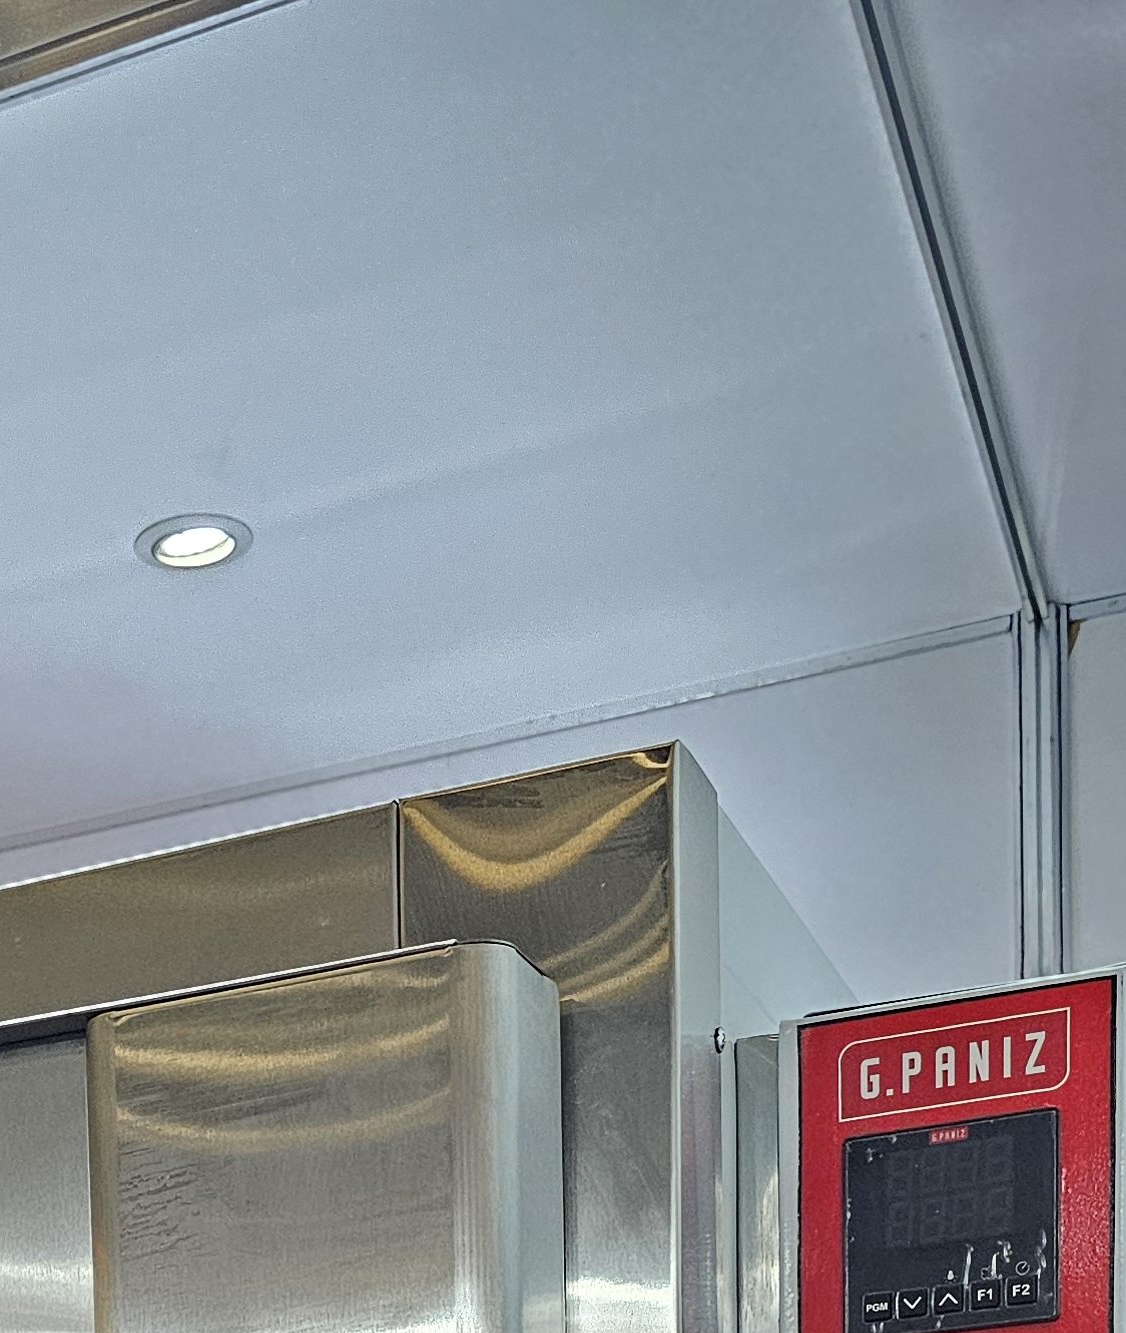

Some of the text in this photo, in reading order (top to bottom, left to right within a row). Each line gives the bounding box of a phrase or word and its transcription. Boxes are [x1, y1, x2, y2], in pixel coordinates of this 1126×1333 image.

[860, 1032, 1046, 1098] G.PANIZ
[930, 1127, 967, 1142] G.PANIZ
[977, 1288, 992, 1301] F1
[1012, 1283, 1030, 1296] F2
[866, 1302, 888, 1312] PGM
